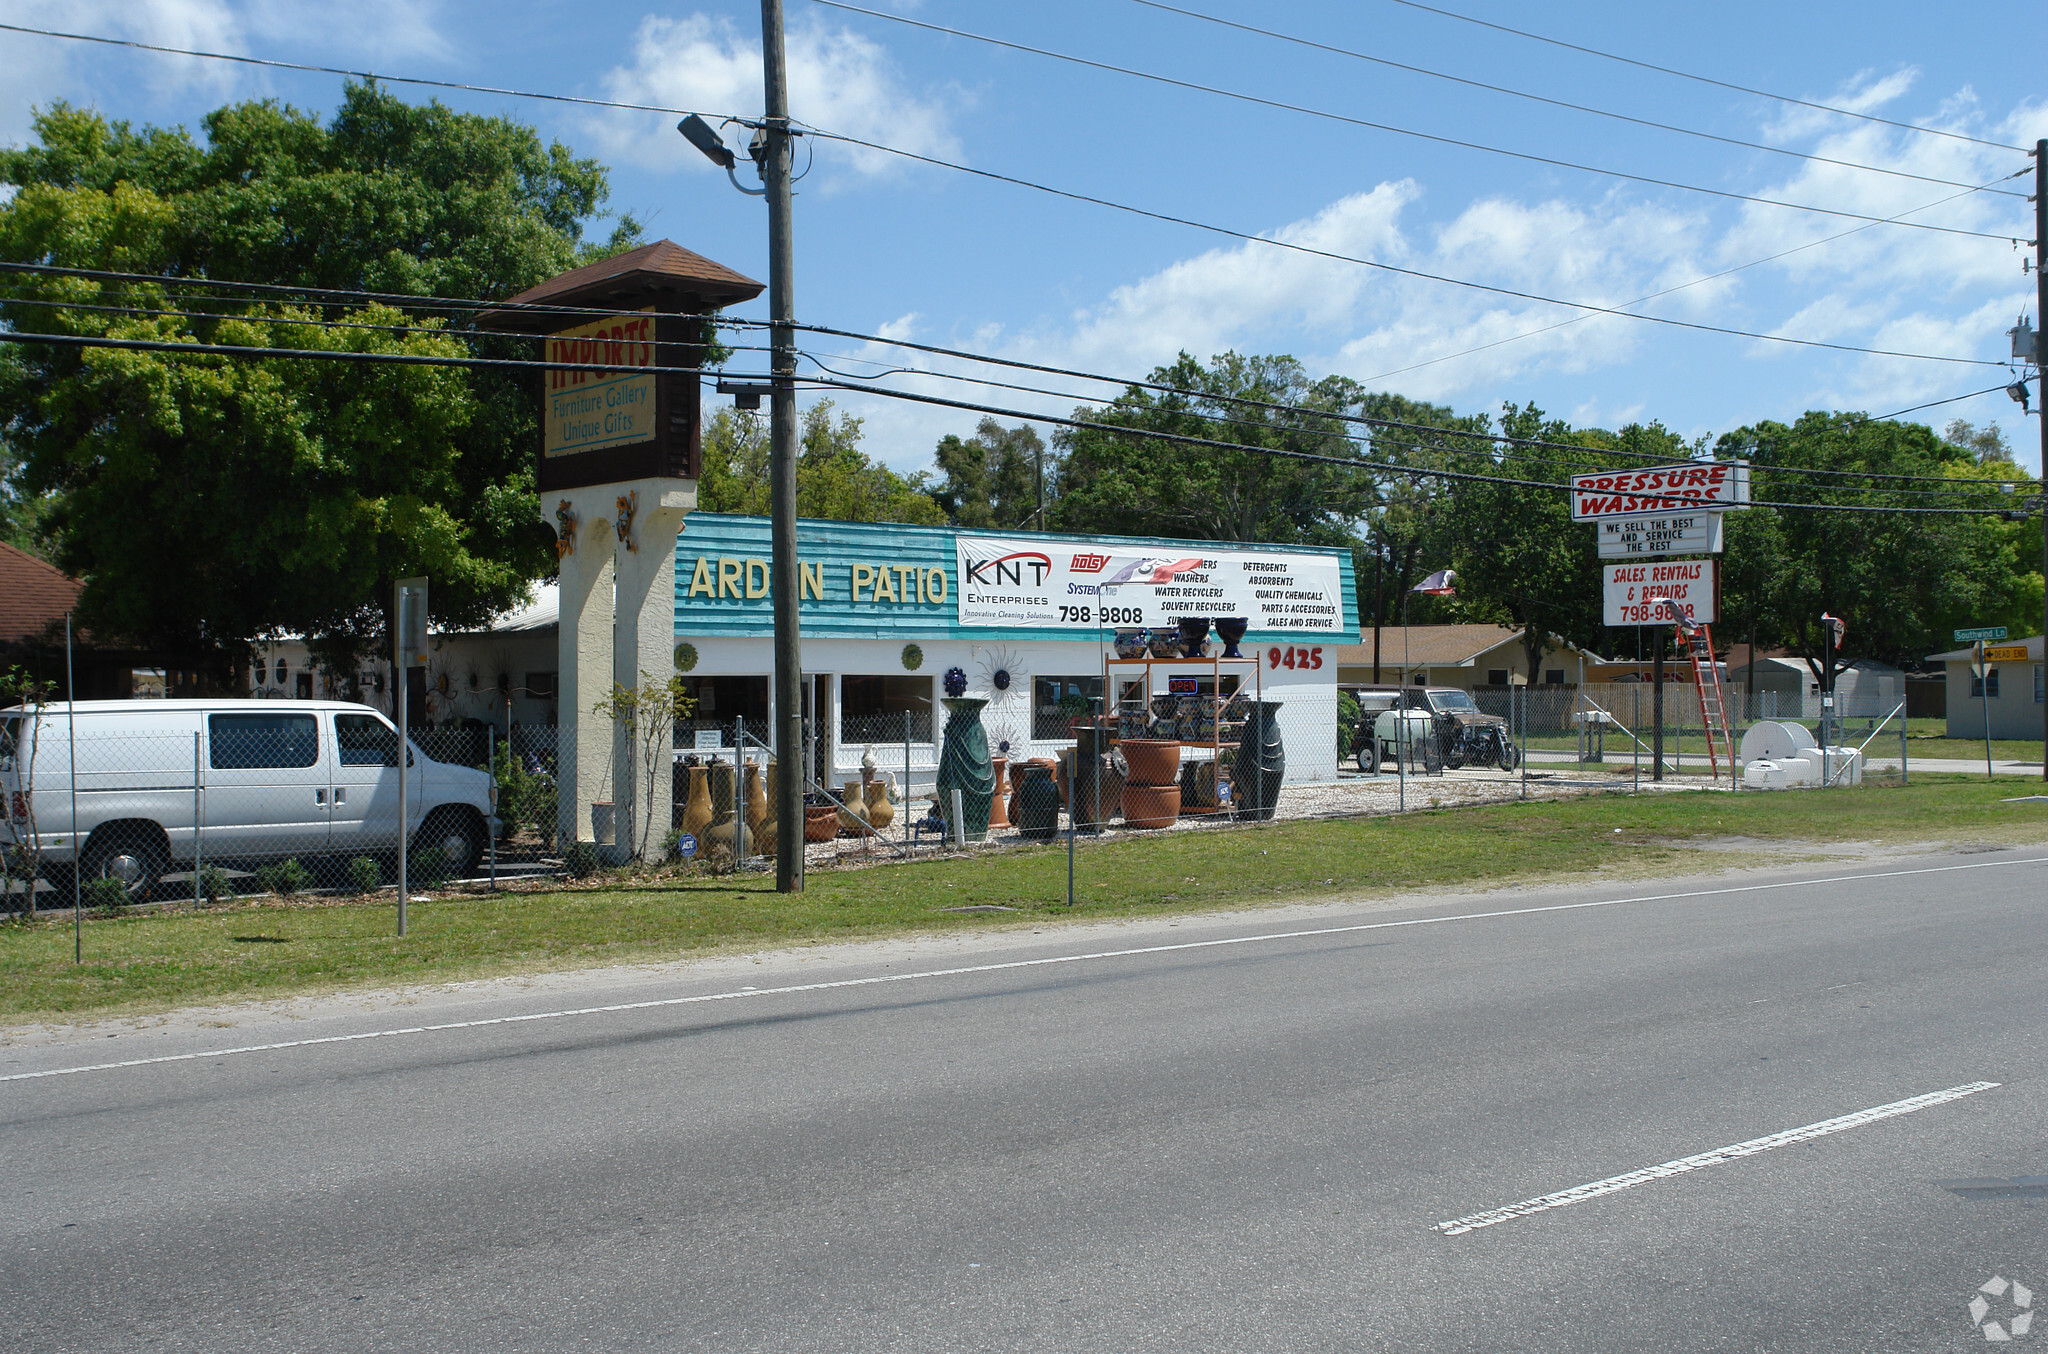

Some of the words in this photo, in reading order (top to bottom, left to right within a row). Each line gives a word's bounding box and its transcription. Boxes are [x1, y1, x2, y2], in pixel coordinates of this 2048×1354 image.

[552, 317, 650, 390] IMPORTS
[553, 394, 602, 419] Furniture
[606, 385, 647, 409] Gallery
[563, 420, 600, 442] Unique
[604, 411, 633, 434] Gifts
[1577, 466, 1728, 496] PRESSURE
[1580, 487, 1721, 515] WASHERS
[1606, 524, 1620, 533] WE
[1625, 521, 1645, 532] SELL
[1650, 521, 1667, 530] THE
[1672, 518, 1694, 528] BEST
[1620, 533, 1638, 542] AND
[1646, 530, 1683, 541] SERVICE
[1626, 543, 1642, 552] THE
[1649, 541, 1672, 551] REST
[966, 558, 1049, 587] KNT
[1243, 562, 1287, 572] DETERGENTS
[689, 556, 823, 601] ARDN
[852, 564, 948, 604] PATIO
[1173, 573, 1210, 584] WASHERS
[1652, 565, 1702, 583] RENTALS
[1248, 576, 1294, 586] ABSORBENTS
[1154, 587, 1181, 597] WATER
[1182, 587, 1224, 598] RECYCLERS
[1255, 590, 1283, 600] QUALITY
[1284, 591, 1323, 601] CHEMICALS
[1627, 587, 1635, 601] &
[1642, 584, 1688, 600] REPAIRS
[967, 593, 1048, 605] ENTERPRISES
[1161, 601, 1194, 611] SOLVENT
[1195, 602, 1236, 612] RECYCLERS
[1261, 604, 1283, 613] PARTS
[1284, 605, 1290, 613] &
[1290, 604, 1335, 615] ACCESSORIES
[964, 609, 996, 618] Innovative
[998, 611, 1024, 619] Cleaning
[1058, 605, 1143, 624] 798-9808
[1267, 618, 1288, 627] SALES
[1289, 618, 1303, 627] AND
[1304, 618, 1333, 628] SERVICE
[1955, 629, 1993, 640] Southwind
[1996, 628, 2006, 637] Ln
[1268, 646, 1323, 670] 9425
[1994, 650, 2010, 658] DEAD
[2013, 649, 2026, 658] END
[1169, 680, 1195, 693] OPEN
